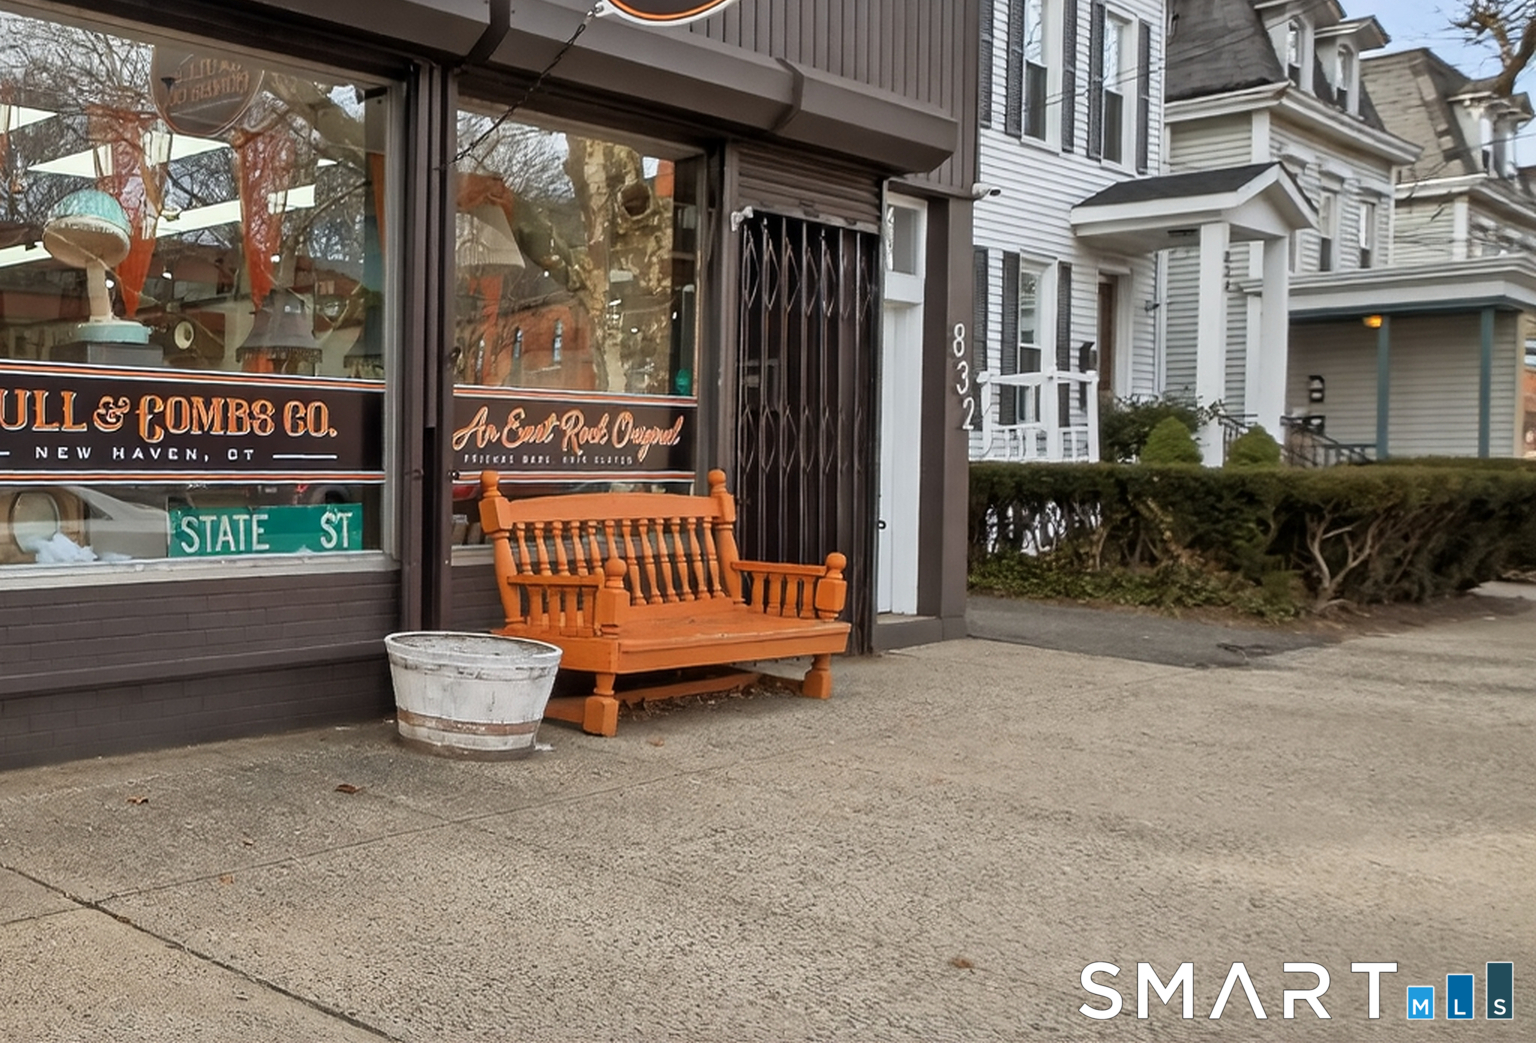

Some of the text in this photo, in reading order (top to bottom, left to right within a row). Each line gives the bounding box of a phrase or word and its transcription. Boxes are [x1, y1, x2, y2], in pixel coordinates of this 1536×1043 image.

[952, 323, 975, 431] 832
[92, 395, 131, 432] &
[135, 394, 276, 444] COMBS
[282, 400, 339, 438] CO.
[452, 405, 500, 451] An
[35, 446, 92, 460] NEW
[112, 446, 210, 463] HAVEN,
[180, 510, 353, 554] STATE ST
